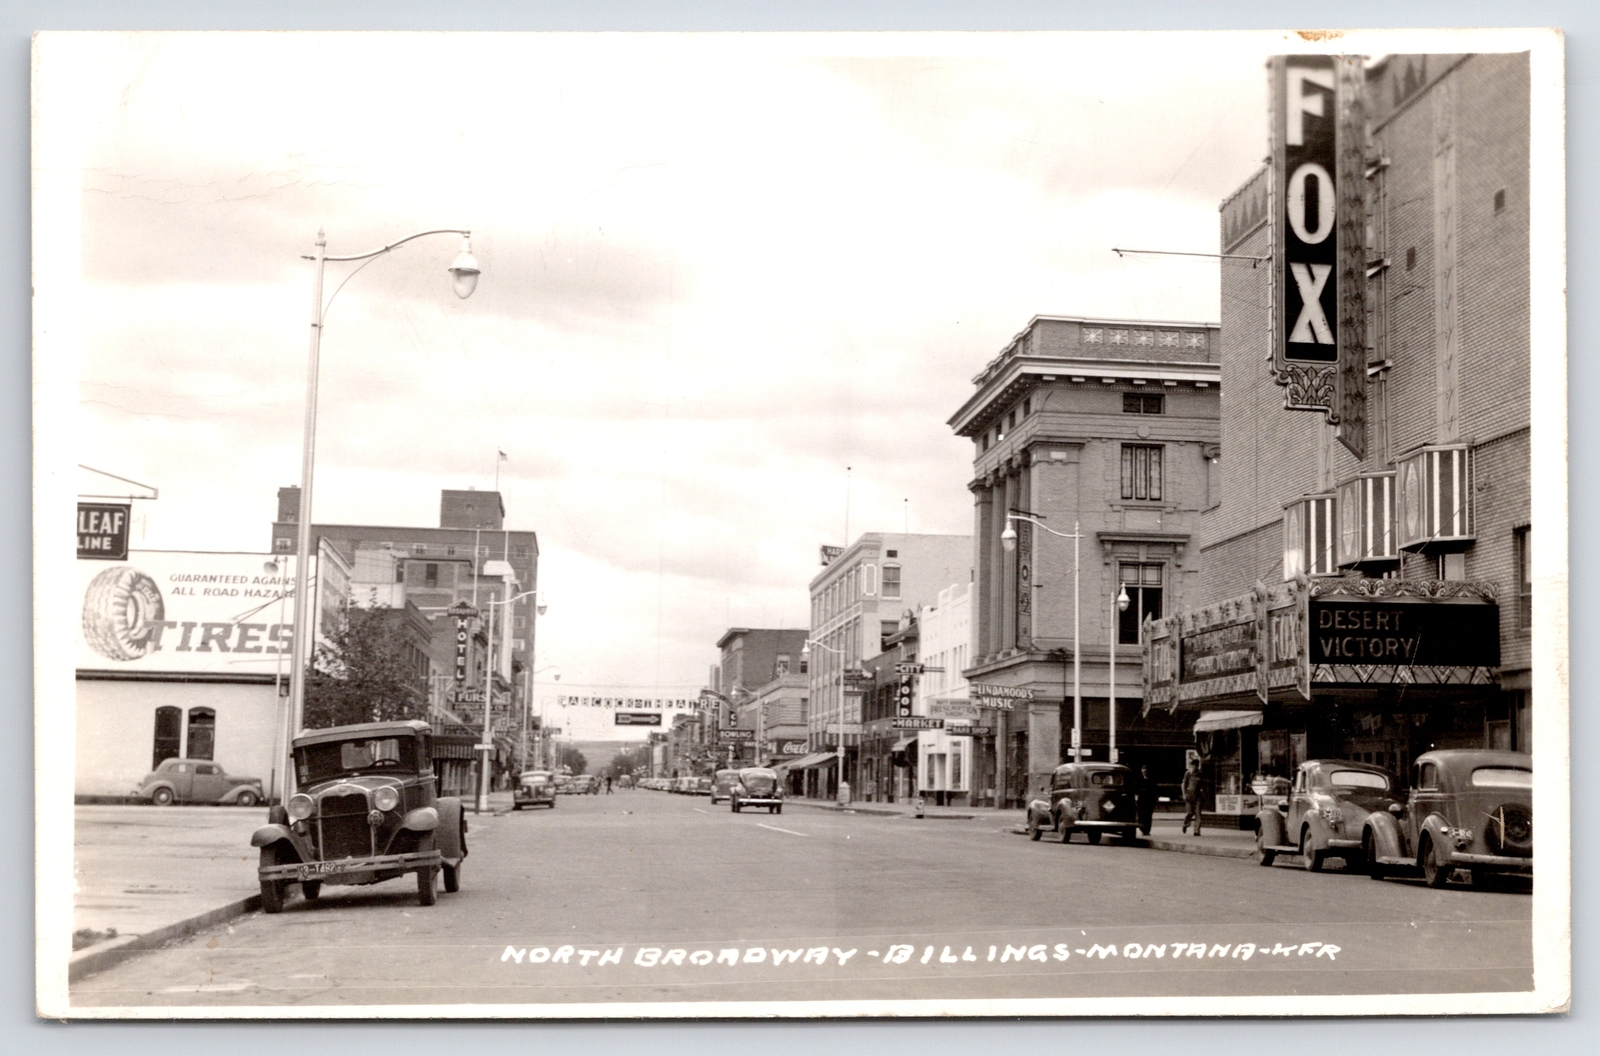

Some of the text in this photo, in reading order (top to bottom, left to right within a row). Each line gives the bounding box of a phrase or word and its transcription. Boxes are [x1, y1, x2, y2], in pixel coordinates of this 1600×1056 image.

[1285, 67, 1336, 344] FOX
[79, 511, 124, 534] LEAF
[77, 536, 112, 550] LINE
[169, 574, 297, 586] GUARANTEED AGAINS
[171, 587, 196, 596] ALL
[203, 588, 239, 597] ROAD
[1319, 609, 1403, 631] DESERT
[142, 620, 294, 654] TIRES
[456, 620, 467, 679] HOTEL
[1319, 637, 1414, 658] VICTORY
[900, 665, 922, 673] CITY
[900, 675, 910, 717] FOOD
[977, 684, 1034, 699] LINDAMOOD'S
[982, 697, 1014, 709] MUSIC
[897, 719, 942, 728] MARKET
